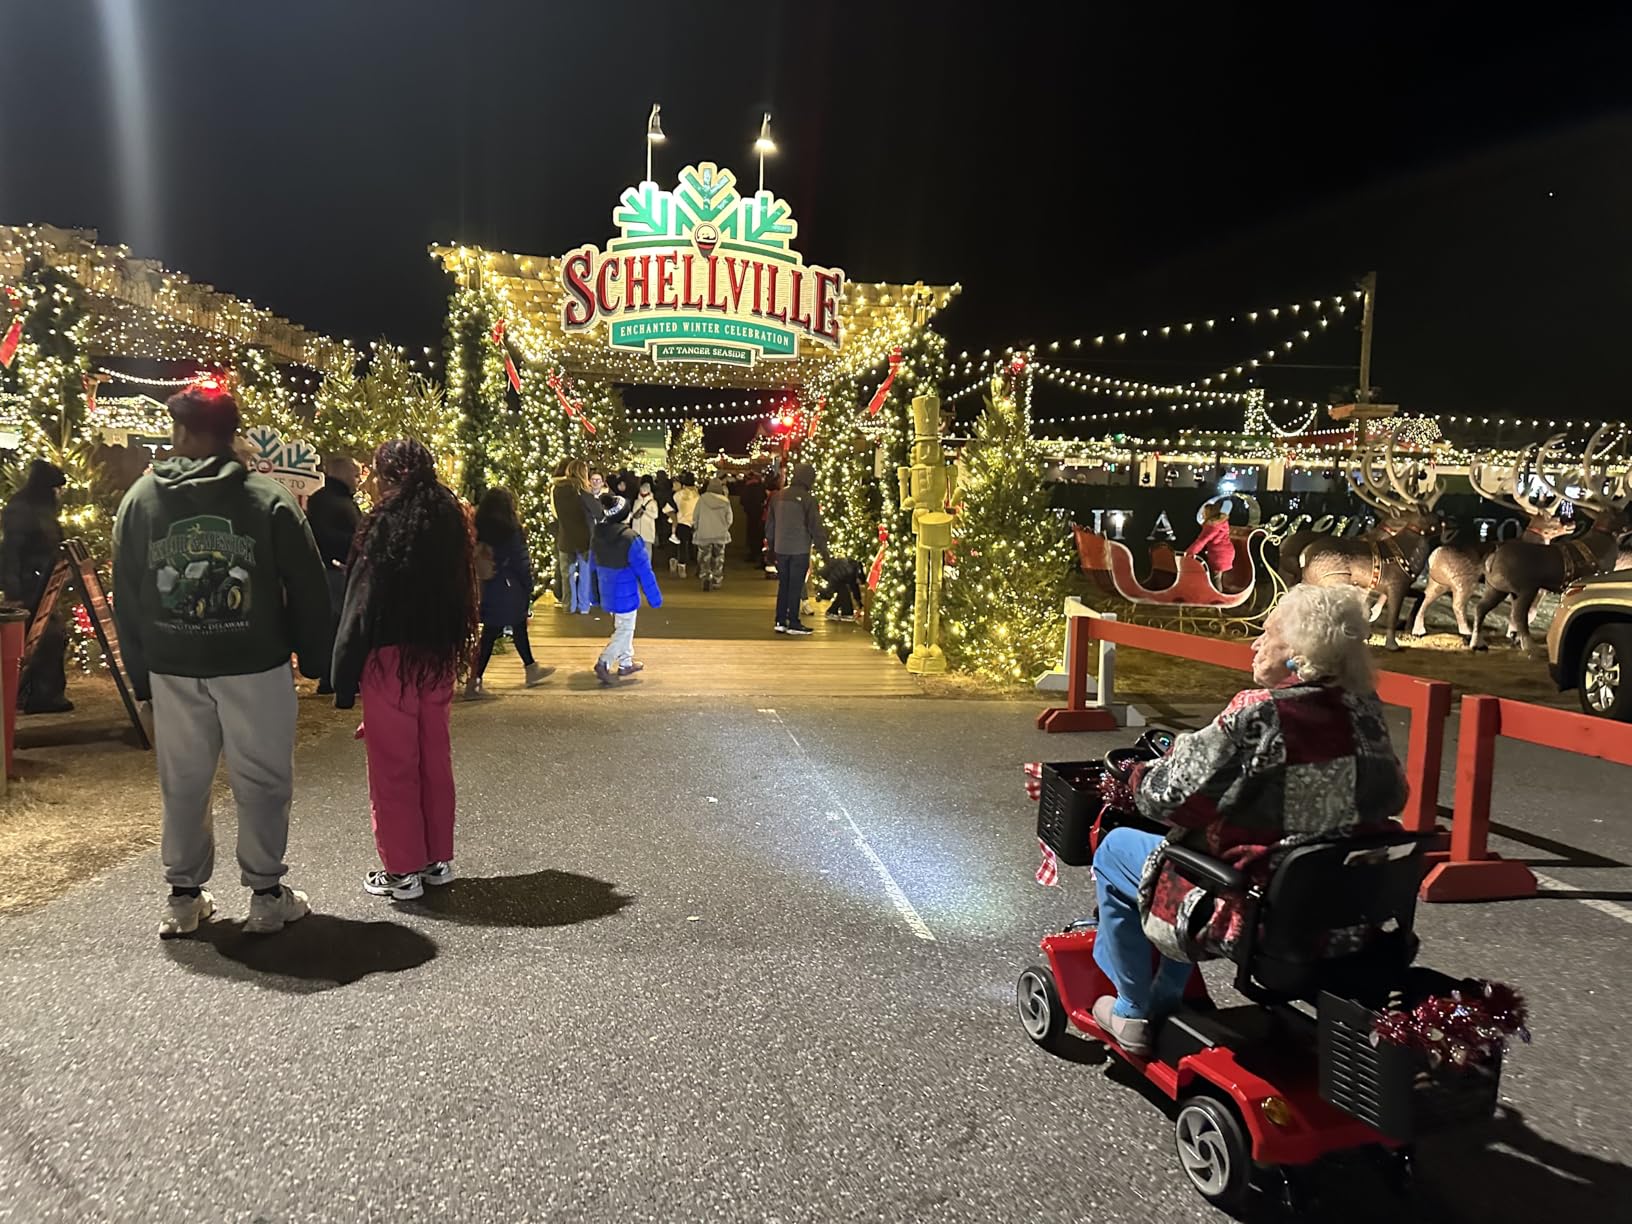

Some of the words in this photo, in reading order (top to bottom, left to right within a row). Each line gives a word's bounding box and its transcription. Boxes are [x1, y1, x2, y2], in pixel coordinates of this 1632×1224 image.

[564, 250, 840, 339] SCHELLVILLE
[620, 321, 678, 337] ENCHANTED
[683, 322, 720, 334] WINTER
[724, 325, 789, 347] CELEBRATION
[662, 346, 675, 355] AT
[676, 347, 710, 356] TANGER
[712, 348, 746, 359] SEASIDE
[290, 480, 305, 489] TO
[1091, 509, 1134, 540] IT
[1146, 510, 1177, 541] A
